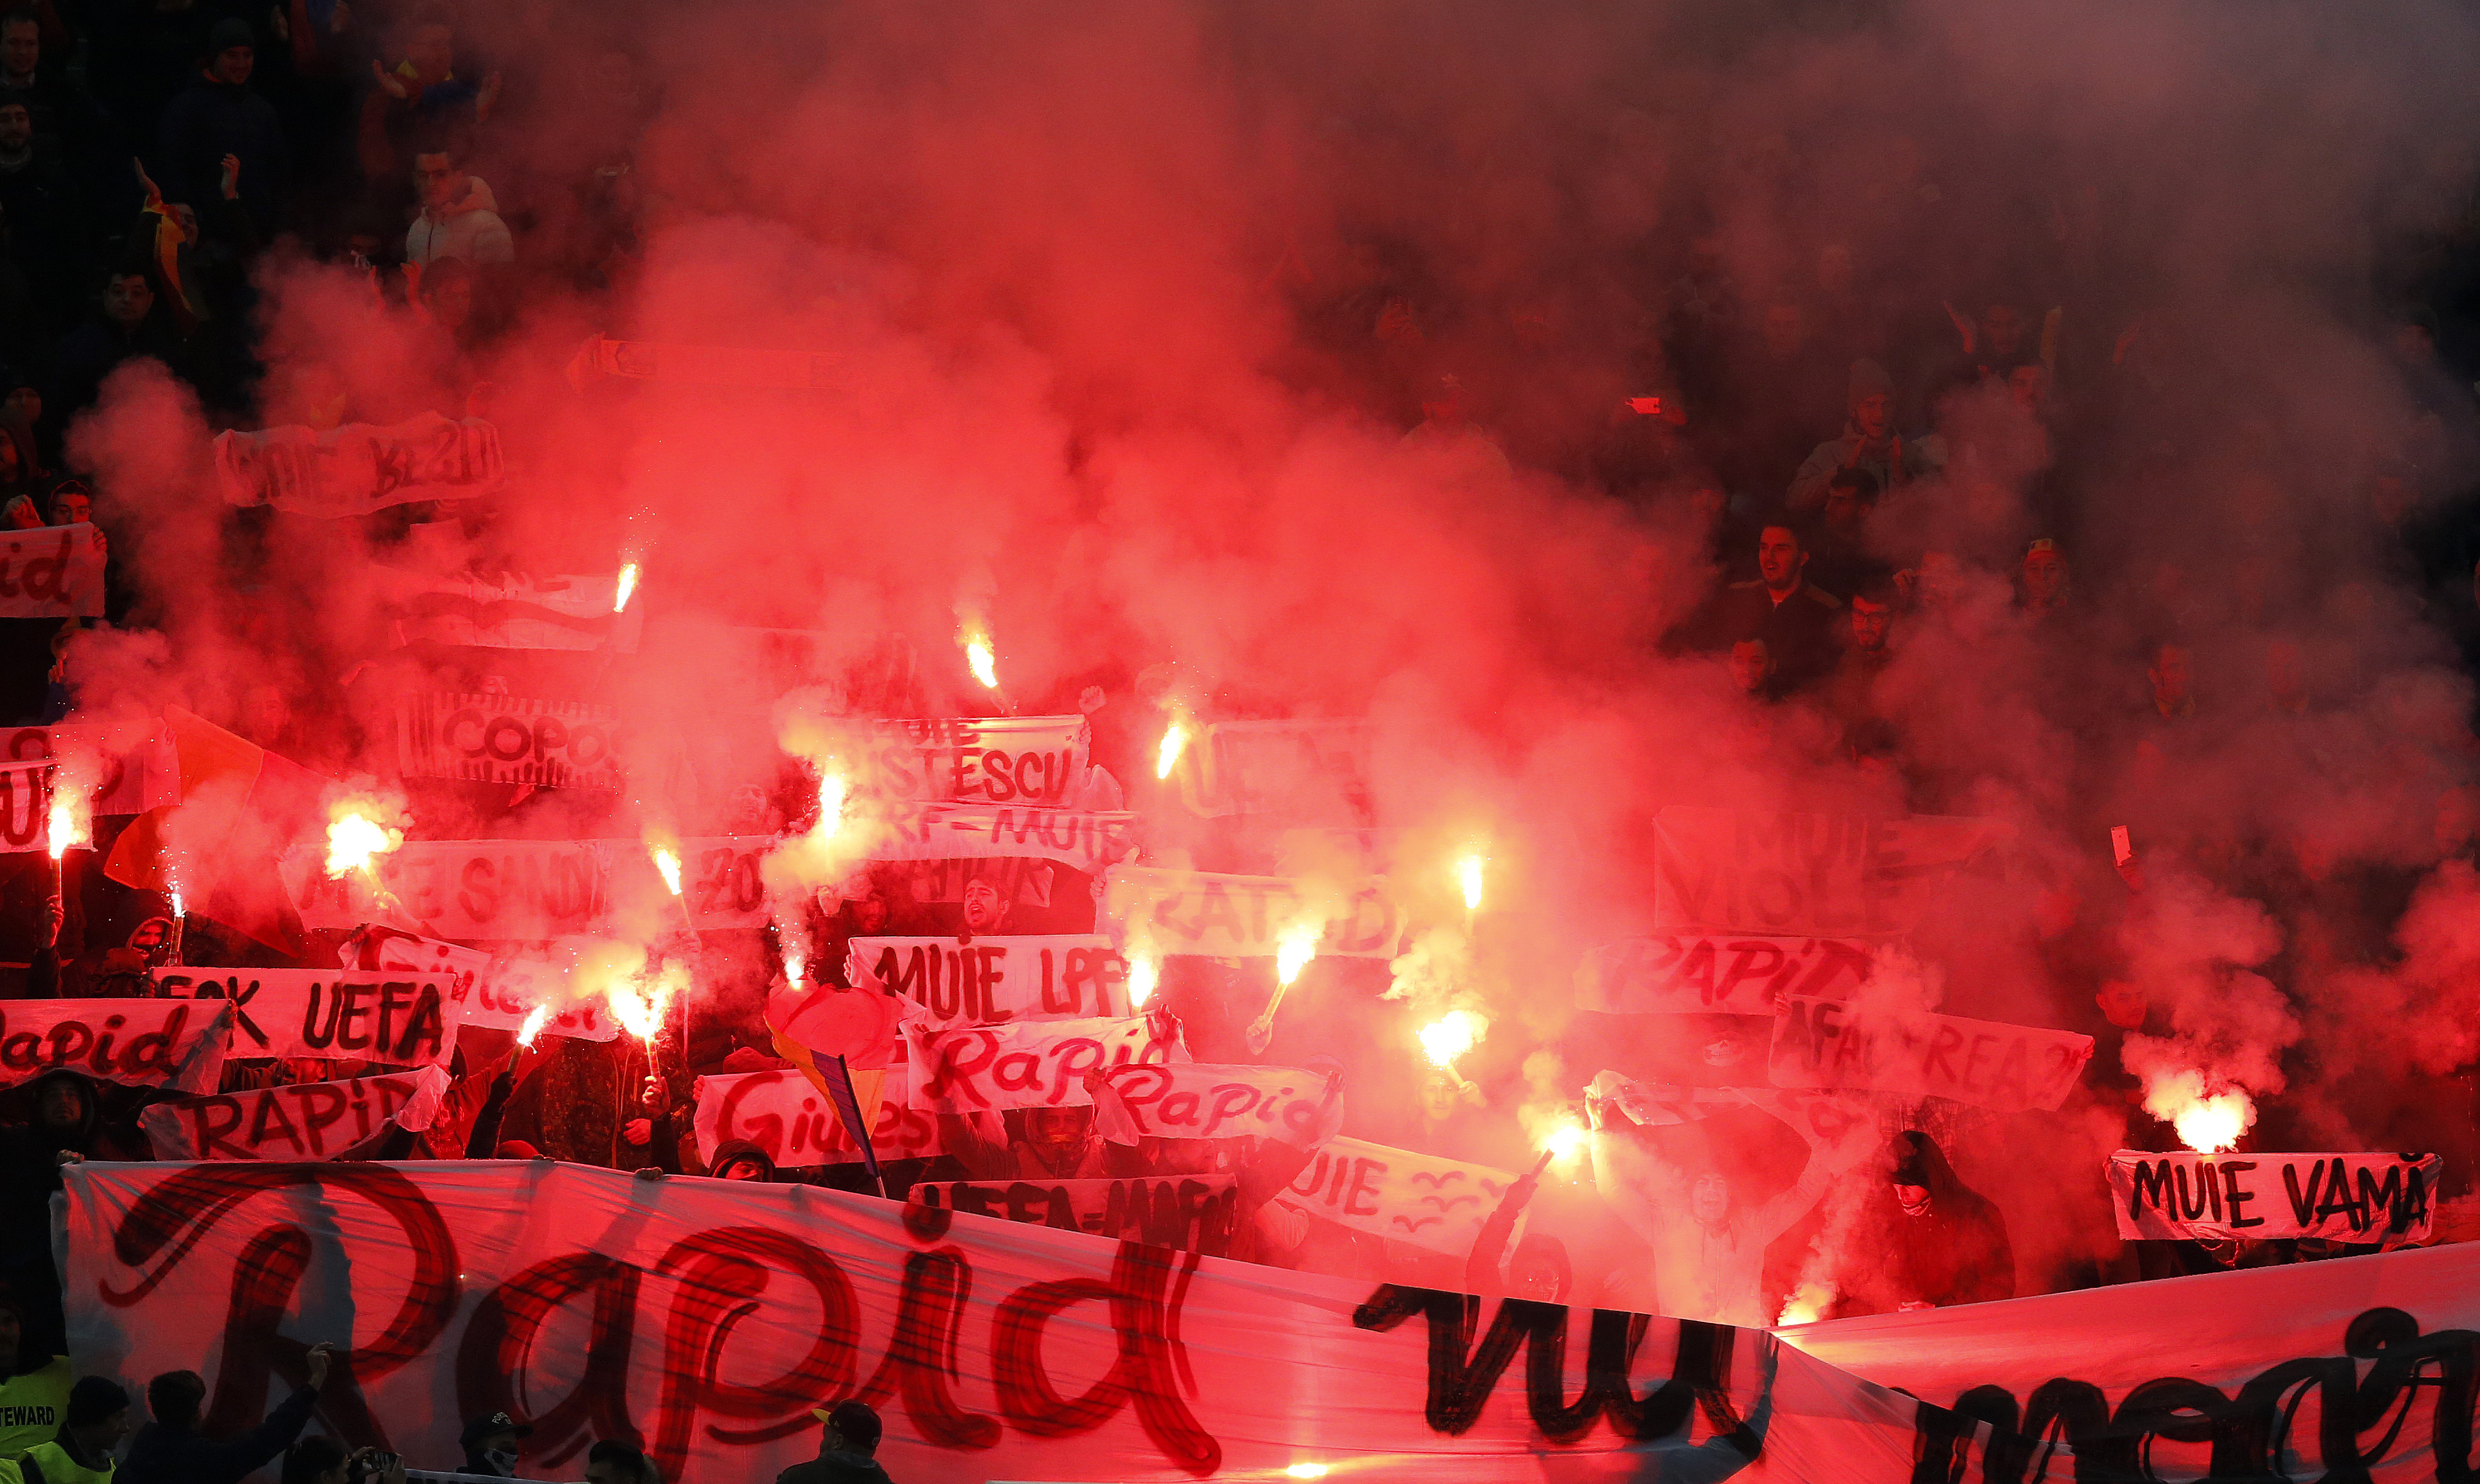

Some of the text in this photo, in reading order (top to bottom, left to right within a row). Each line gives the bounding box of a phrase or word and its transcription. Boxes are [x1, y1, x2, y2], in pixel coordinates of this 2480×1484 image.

[1150, 881, 1397, 953] RAPD
[874, 943, 1013, 1022] MUIE
[0, 1004, 189, 1073] apid
[302, 981, 445, 1061] UEFA
[1286, 1151, 1388, 1215] UIE
[2130, 1152, 2428, 1234] MUIE VAMĂ
[0, 1405, 55, 1427] TEWARD
